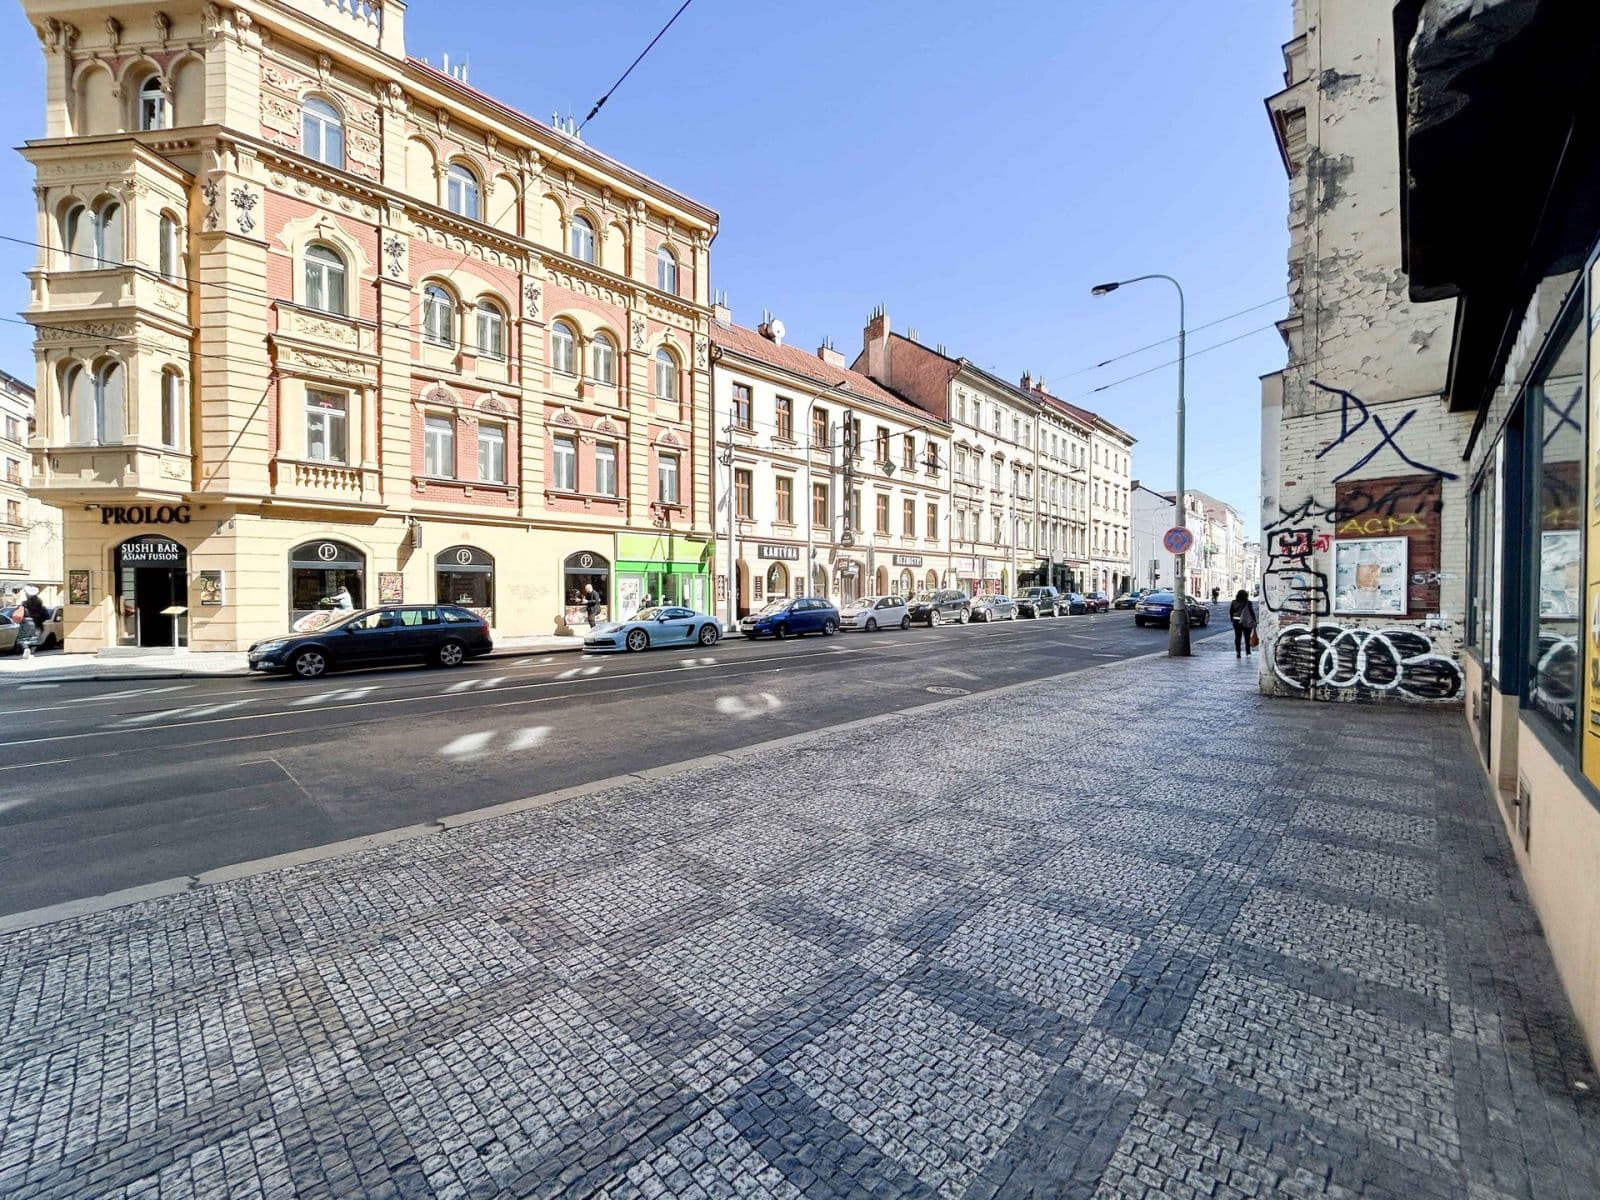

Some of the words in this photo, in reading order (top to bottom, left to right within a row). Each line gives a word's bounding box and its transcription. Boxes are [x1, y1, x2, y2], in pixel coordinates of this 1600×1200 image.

[101, 505, 190, 525] PROLOG
[121, 543, 154, 553] SUSHI
[157, 544, 179, 553] BAR
[122, 553, 146, 561] ASIAN
[148, 553, 179, 561] FUSION
